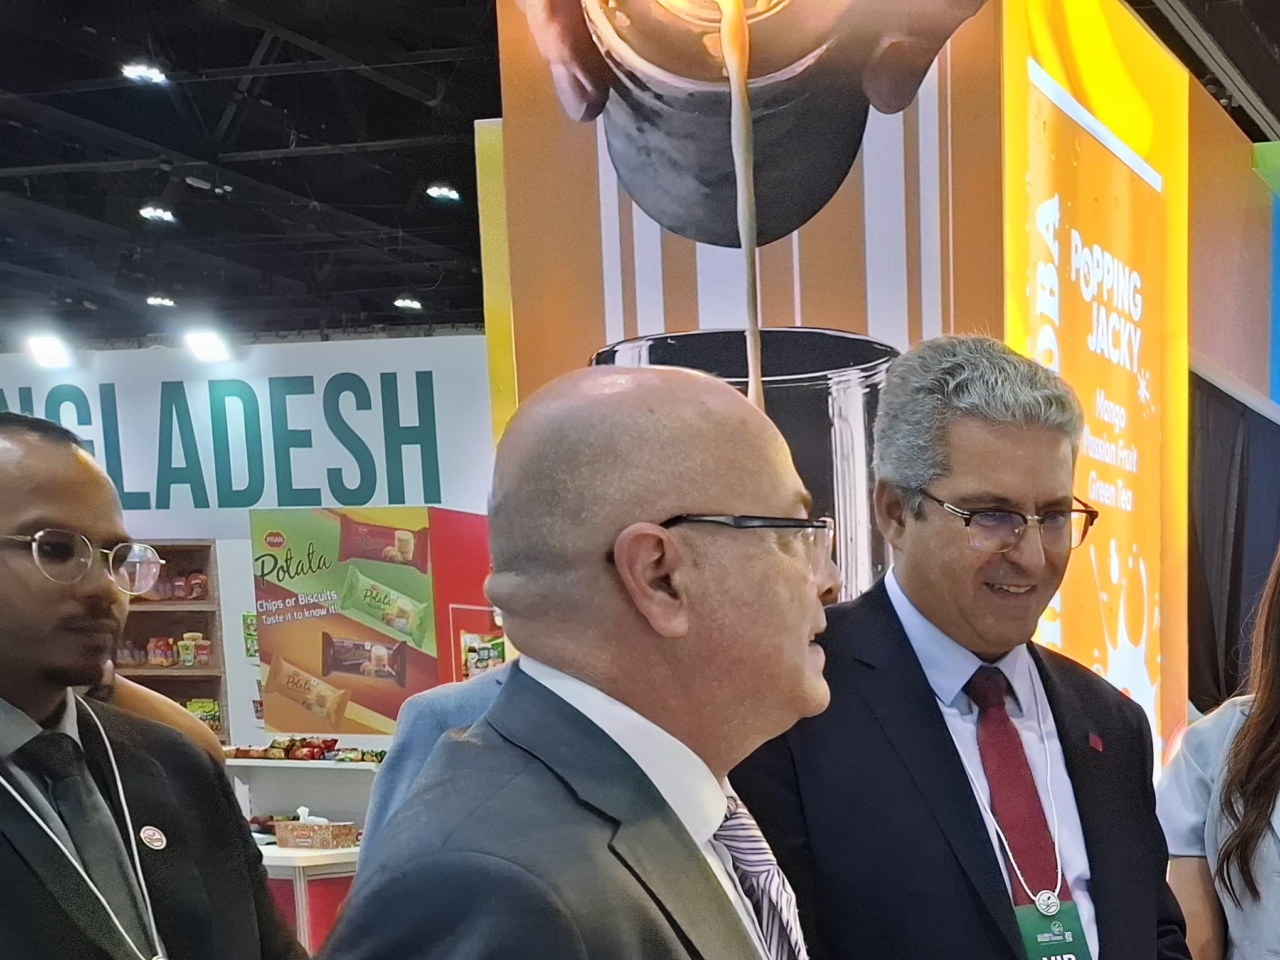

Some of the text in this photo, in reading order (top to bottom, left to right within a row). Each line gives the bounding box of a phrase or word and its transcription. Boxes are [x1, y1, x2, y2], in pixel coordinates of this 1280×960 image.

[1036, 192, 1060, 376] OBA
[1071, 228, 1142, 322] POPPING
[1087, 301, 1142, 373] JACKY
[1095, 388, 1126, 433] Mango
[0, 371, 442, 511] GLADESH
[1116, 440, 1138, 473] Fruit
[1088, 470, 1133, 511] Green Tea
[254, 542, 332, 588] Potata
[257, 588, 338, 614] Chips or Biscuits
[261, 603, 340, 626] Taste it to know it!
